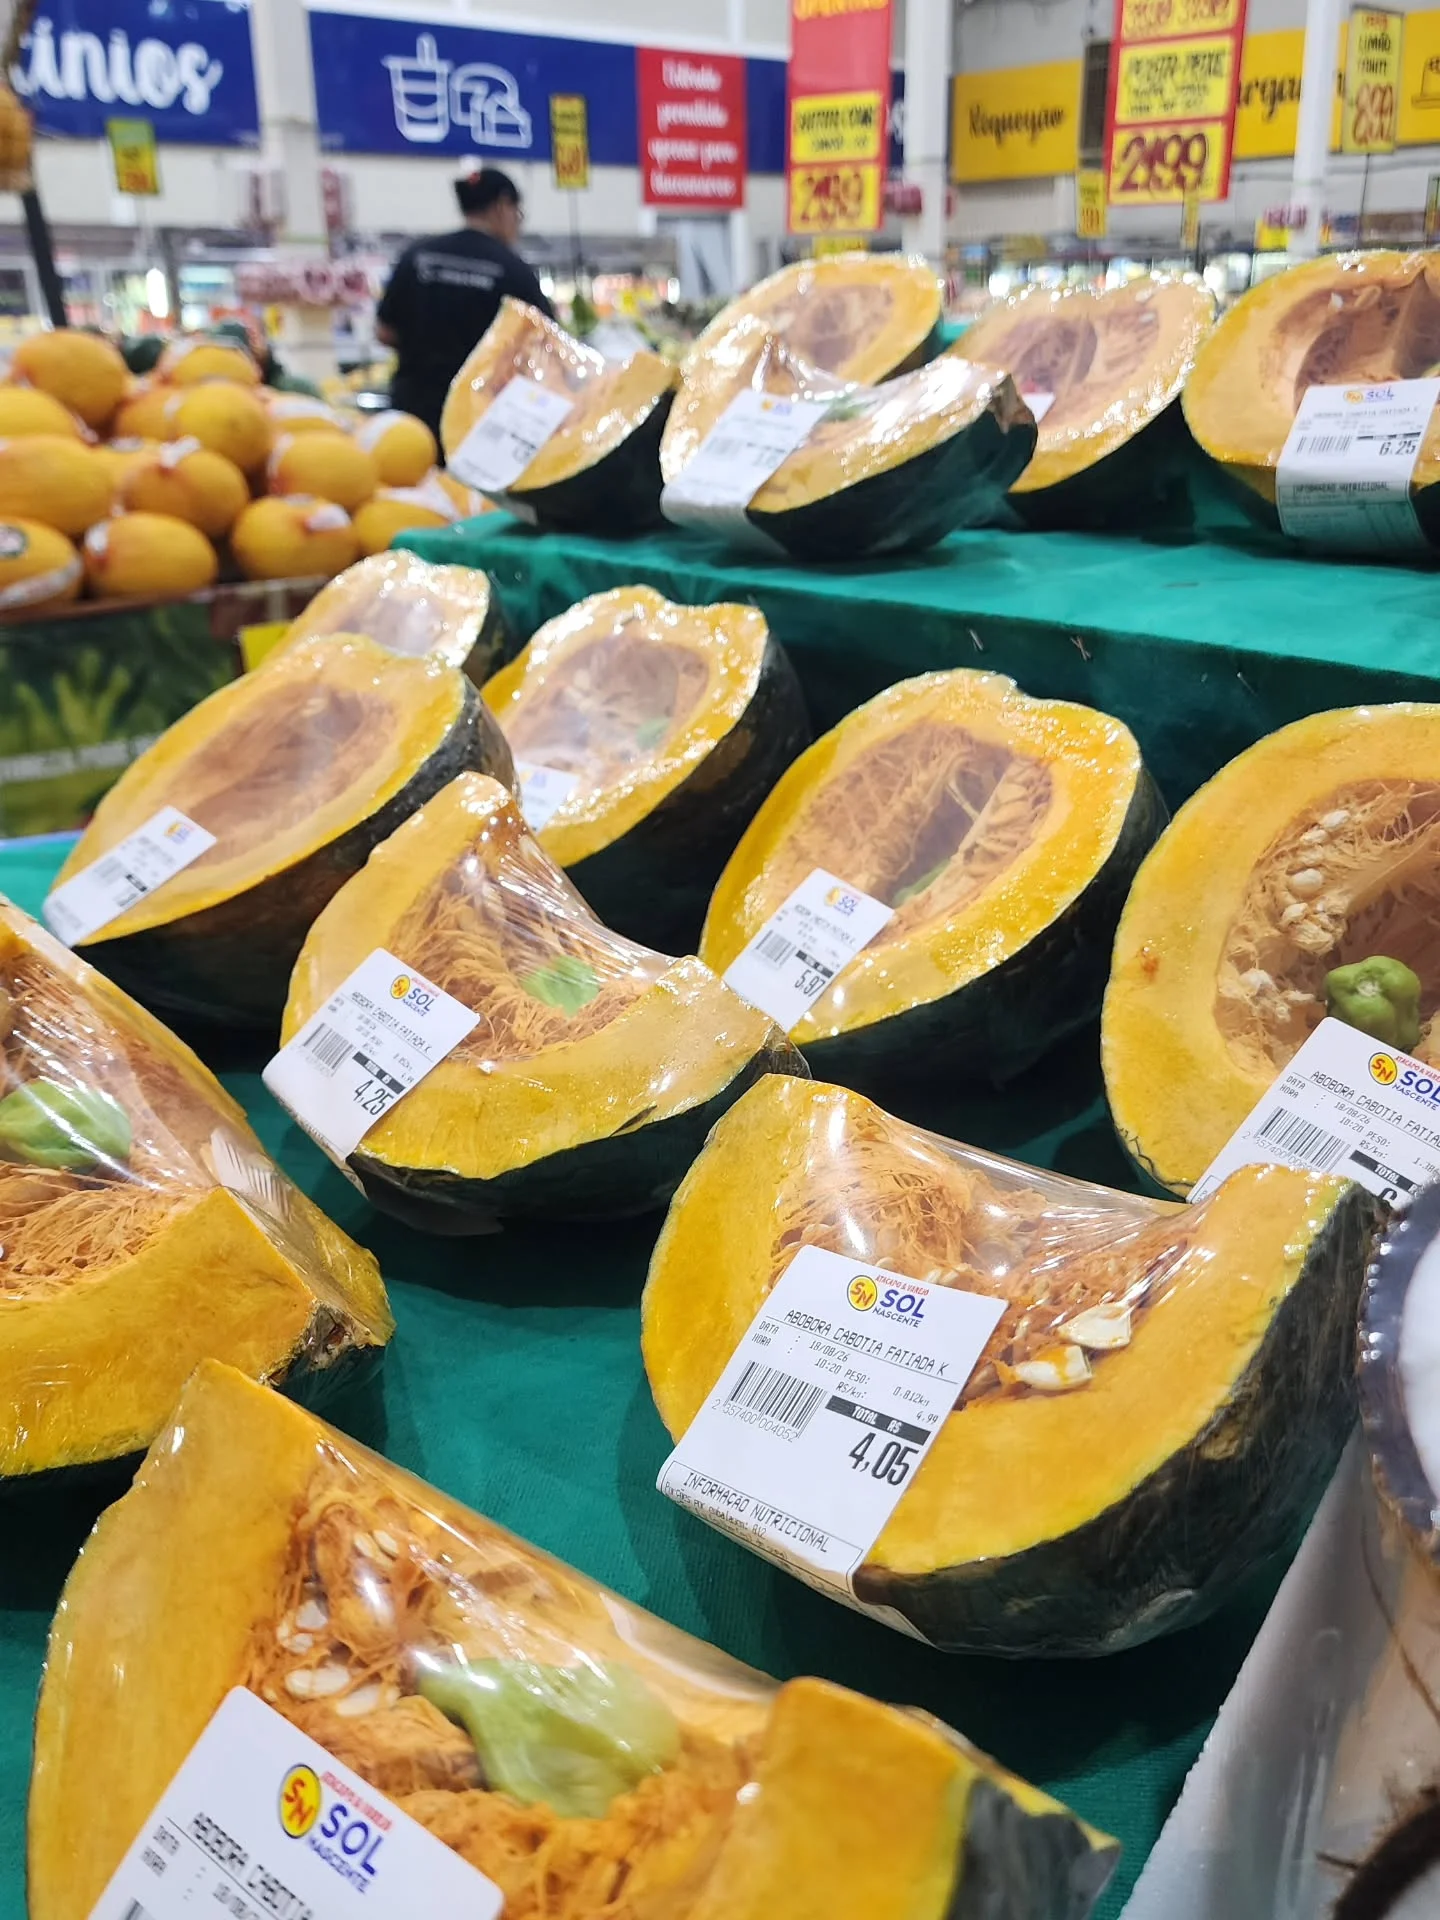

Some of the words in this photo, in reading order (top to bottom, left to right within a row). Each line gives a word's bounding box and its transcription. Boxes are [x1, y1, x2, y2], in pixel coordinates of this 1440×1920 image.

[407, 987, 435, 1012] SOL
[353, 1079, 394, 1115] 4,25
[1280, 1083, 1299, 1099] HORA
[1286, 1075, 1306, 1090] DATA
[1310, 1071, 1355, 1100] ABOBORA
[1356, 1095, 1403, 1125] CABOTIA
[1372, 1058, 1394, 1081] SN
[1400, 1070, 1440, 1104] SOL
[1392, 1083, 1439, 1111] NASCENTE
[1374, 1163, 1401, 1185] TOTAL
[875, 1274, 902, 1288] ATACADO
[850, 1281, 874, 1307] SN
[879, 1288, 926, 1319] SOL
[872, 1306, 921, 1329] NASCENTE
[751, 1332, 772, 1347] HORA
[814, 1356, 843, 1375] 10:20
[844, 1368, 871, 1385] PESO:
[758, 1319, 780, 1335] DATA
[808, 1339, 850, 1363] 18/08/26
[784, 1309, 832, 1336] ABOBORA
[833, 1327, 884, 1356] CABOTIA
[884, 1345, 936, 1373] FATIADA
[937, 1361, 950, 1377] K
[852, 1405, 879, 1426] TOTAL
[848, 1431, 920, 1486] 4,05
[683, 1471, 750, 1513] INFORMAÇÃO
[749, 1502, 831, 1554] NUTRICIONAL
[320, 1803, 384, 1876] SOL
